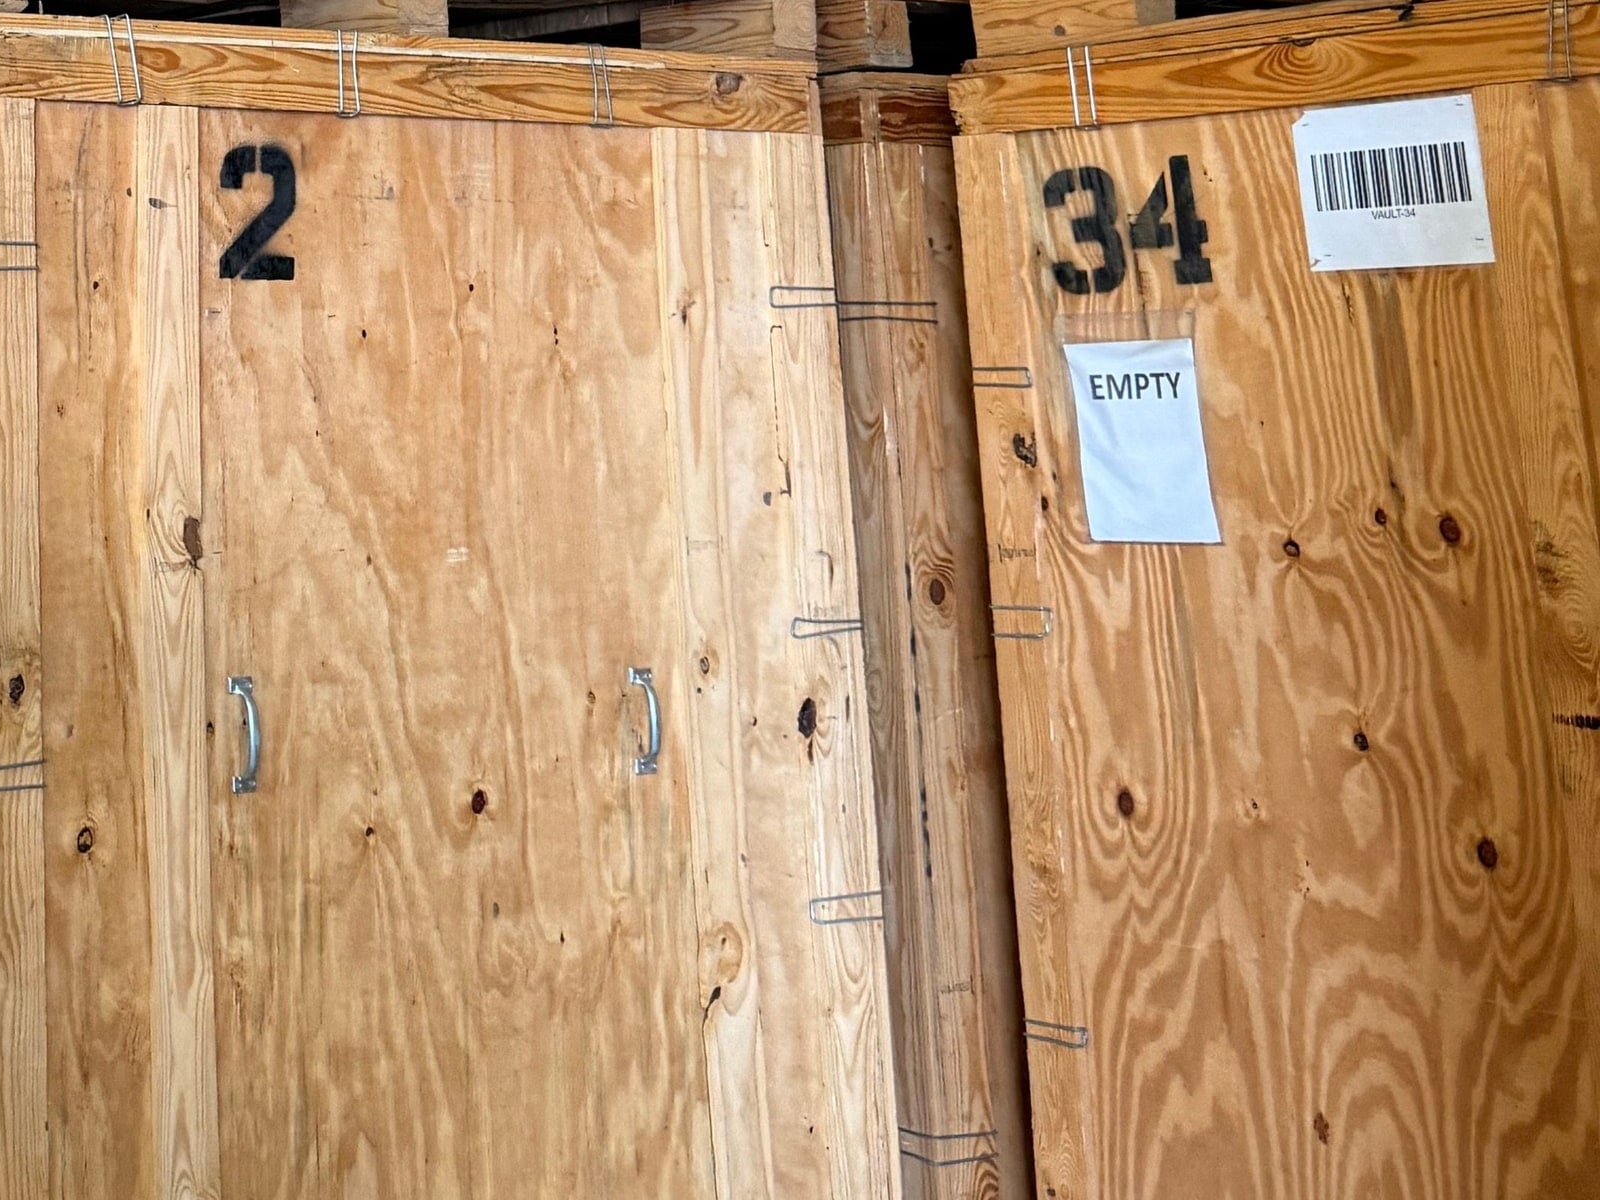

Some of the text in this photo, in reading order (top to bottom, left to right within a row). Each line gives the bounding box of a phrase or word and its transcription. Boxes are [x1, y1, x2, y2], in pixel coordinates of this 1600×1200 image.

[218, 144, 297, 281] 2
[1043, 154, 1213, 295] 34
[1371, 207, 1417, 220] VAULT-34
[1088, 371, 1181, 401] EMPTY
